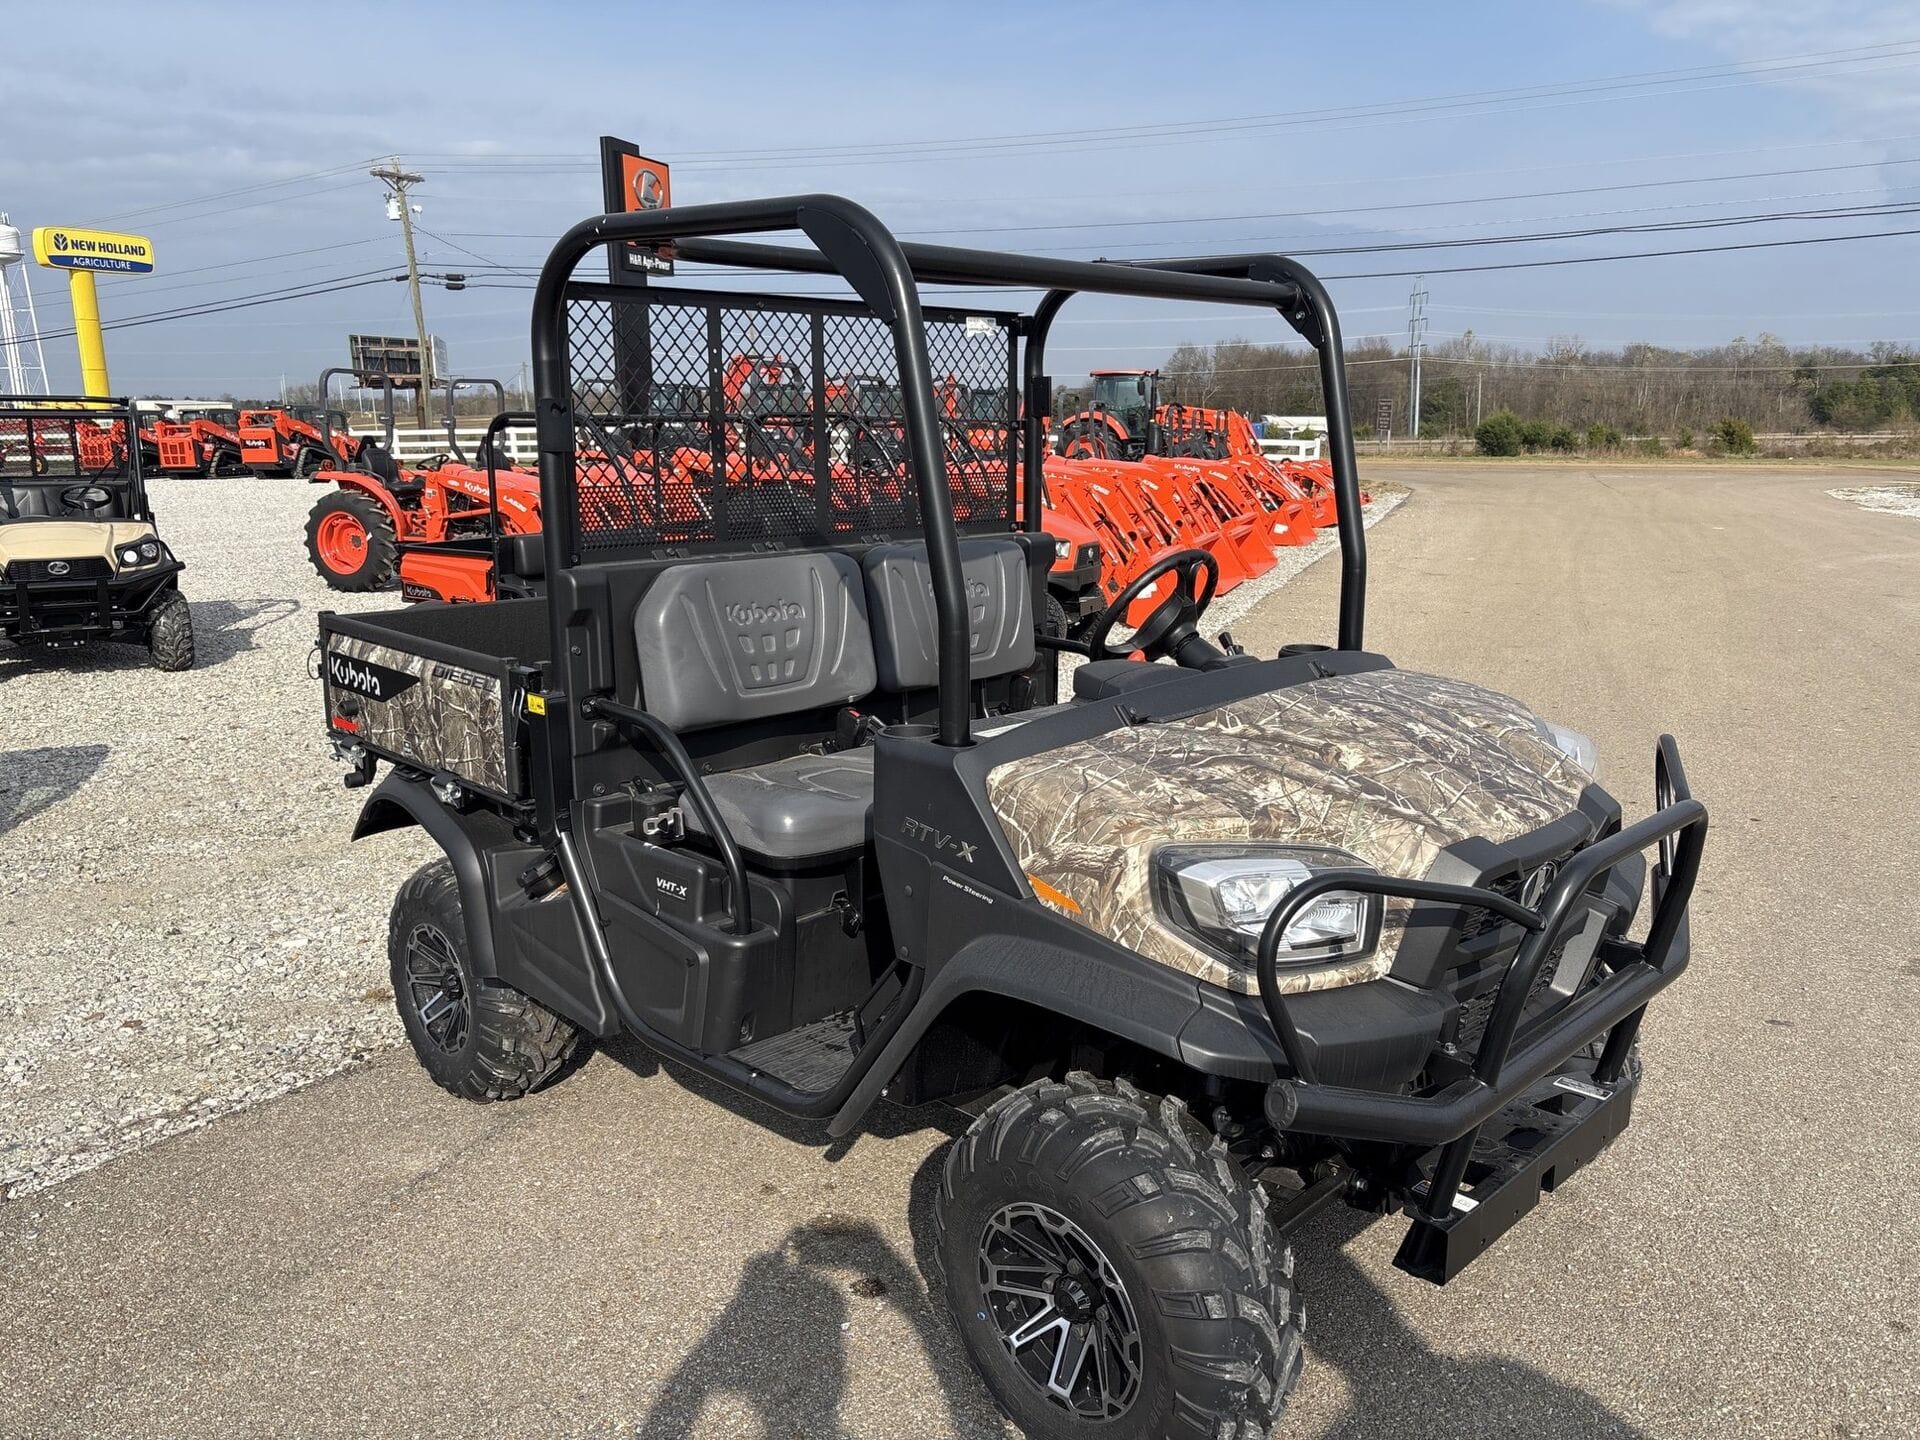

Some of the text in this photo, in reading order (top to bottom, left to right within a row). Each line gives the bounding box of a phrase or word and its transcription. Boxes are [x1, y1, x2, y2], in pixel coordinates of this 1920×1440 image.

[71, 239, 146, 256] NEW HOLLAND
[72, 257, 131, 269] AGRICULTURE
[629, 253, 671, 270] H&R Agri-Power
[725, 598, 806, 626] Kubota
[330, 656, 381, 697] Kubota
[902, 816, 978, 863] RTV-X
[656, 876, 688, 897] VHT-X
[942, 875, 994, 904] Power Steering
